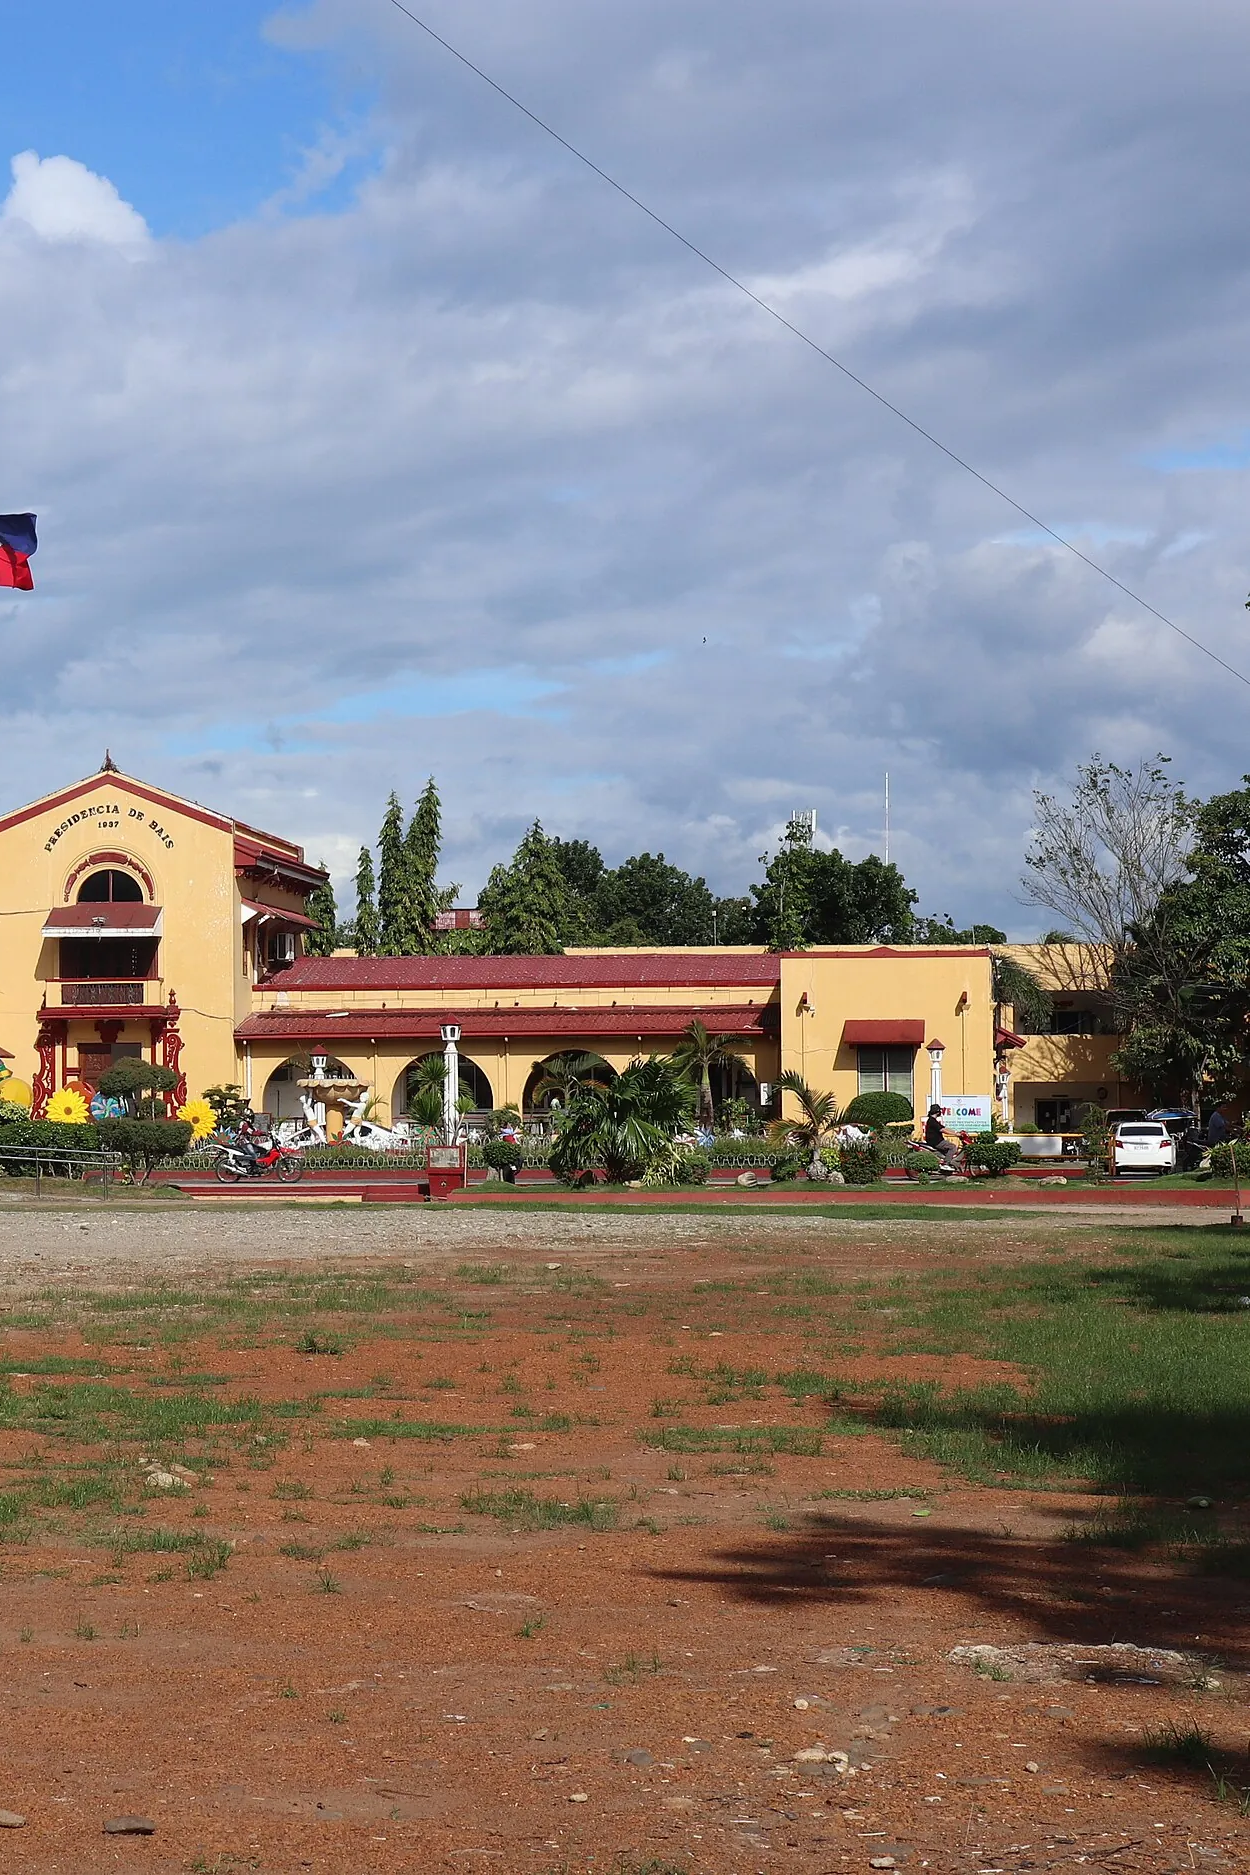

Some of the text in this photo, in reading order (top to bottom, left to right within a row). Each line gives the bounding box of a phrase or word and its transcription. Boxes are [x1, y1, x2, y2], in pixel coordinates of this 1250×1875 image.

[44, 805, 174, 852] PRESIDENCIA DE BAIS
